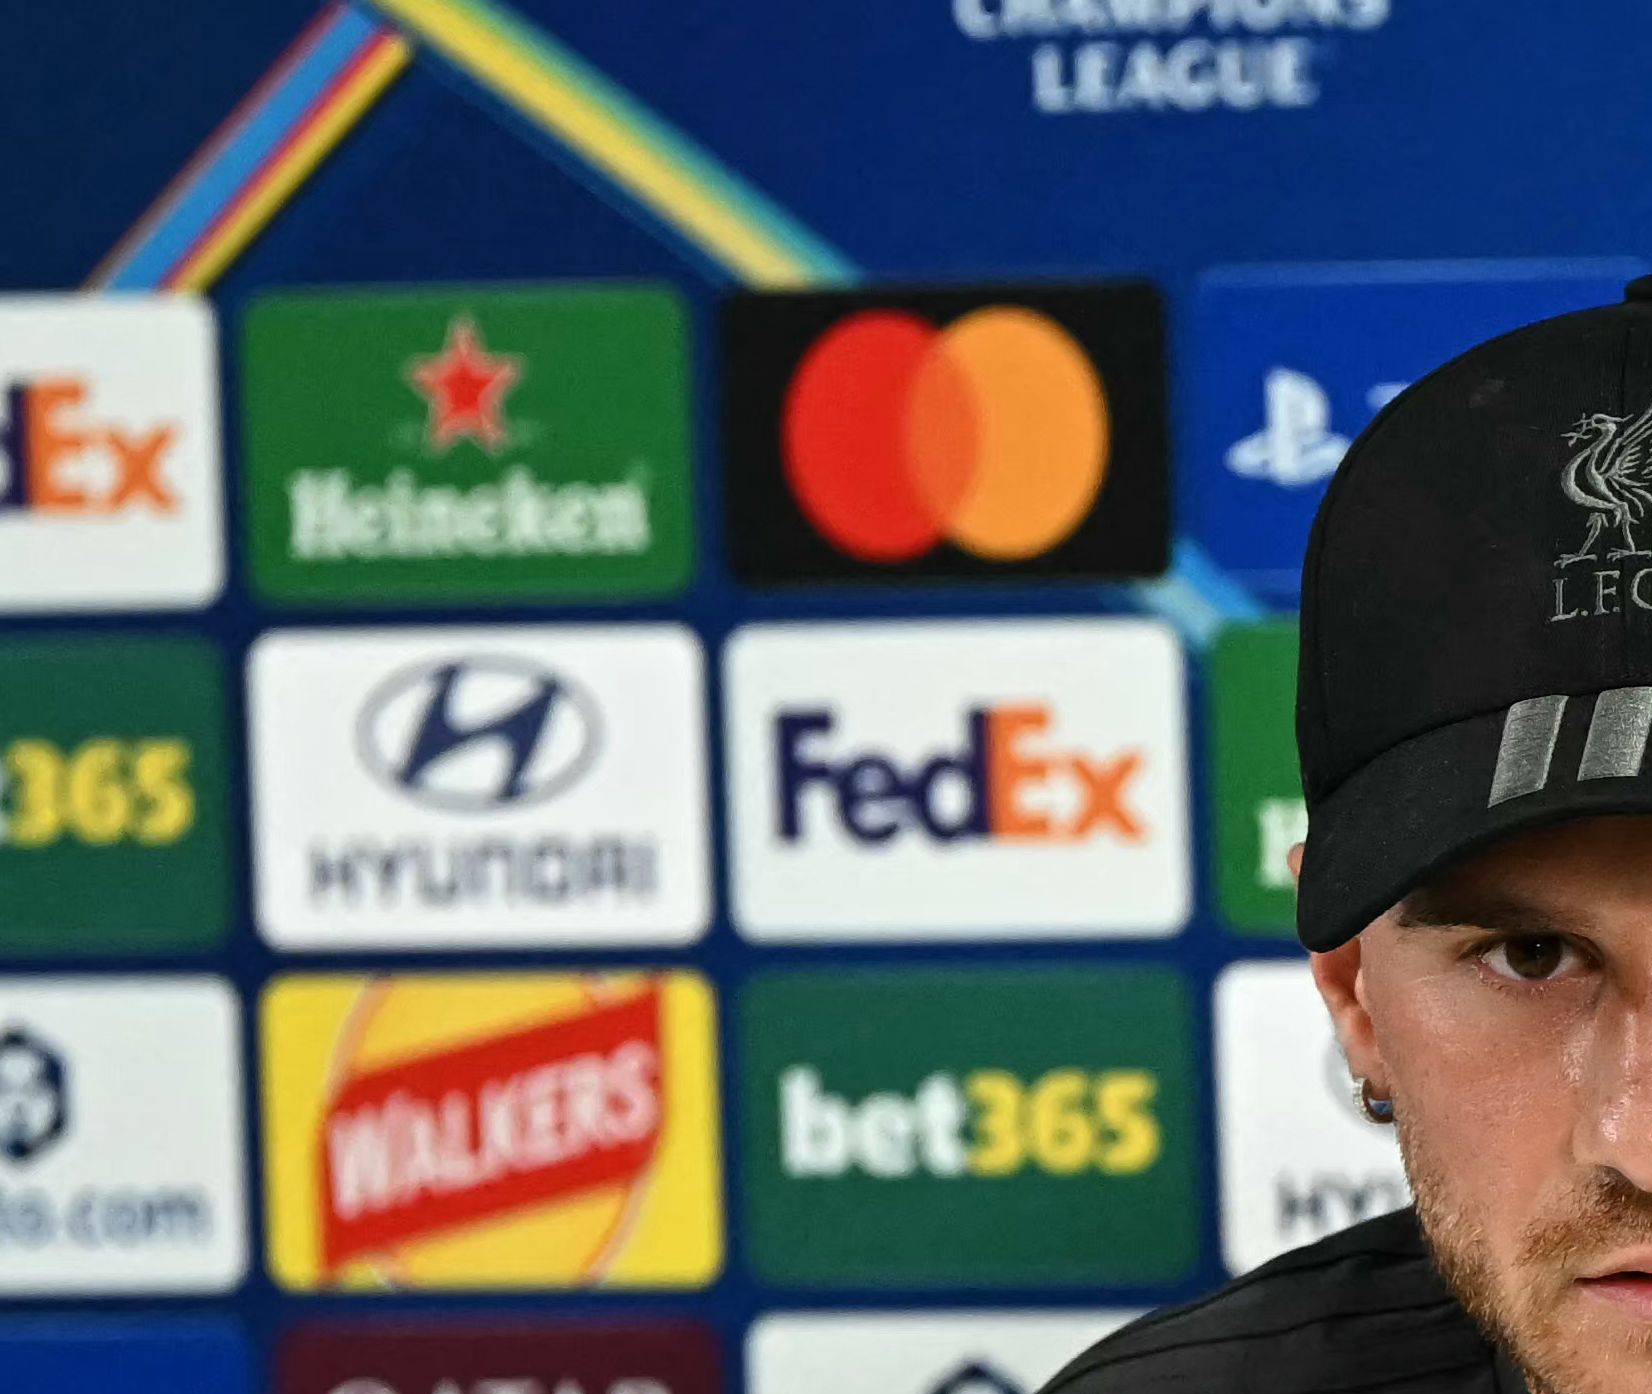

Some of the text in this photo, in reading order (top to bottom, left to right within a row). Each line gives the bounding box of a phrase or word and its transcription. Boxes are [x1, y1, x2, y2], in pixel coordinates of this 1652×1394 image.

[1032, 37, 1320, 114] LEAGUE
[288, 468, 651, 560] Heineken
[773, 703, 1150, 846] FedEx
[308, 832, 660, 907] HYUNDAI
[328, 1039, 660, 1222] WALKERS
[779, 1064, 1161, 1177] bet365
